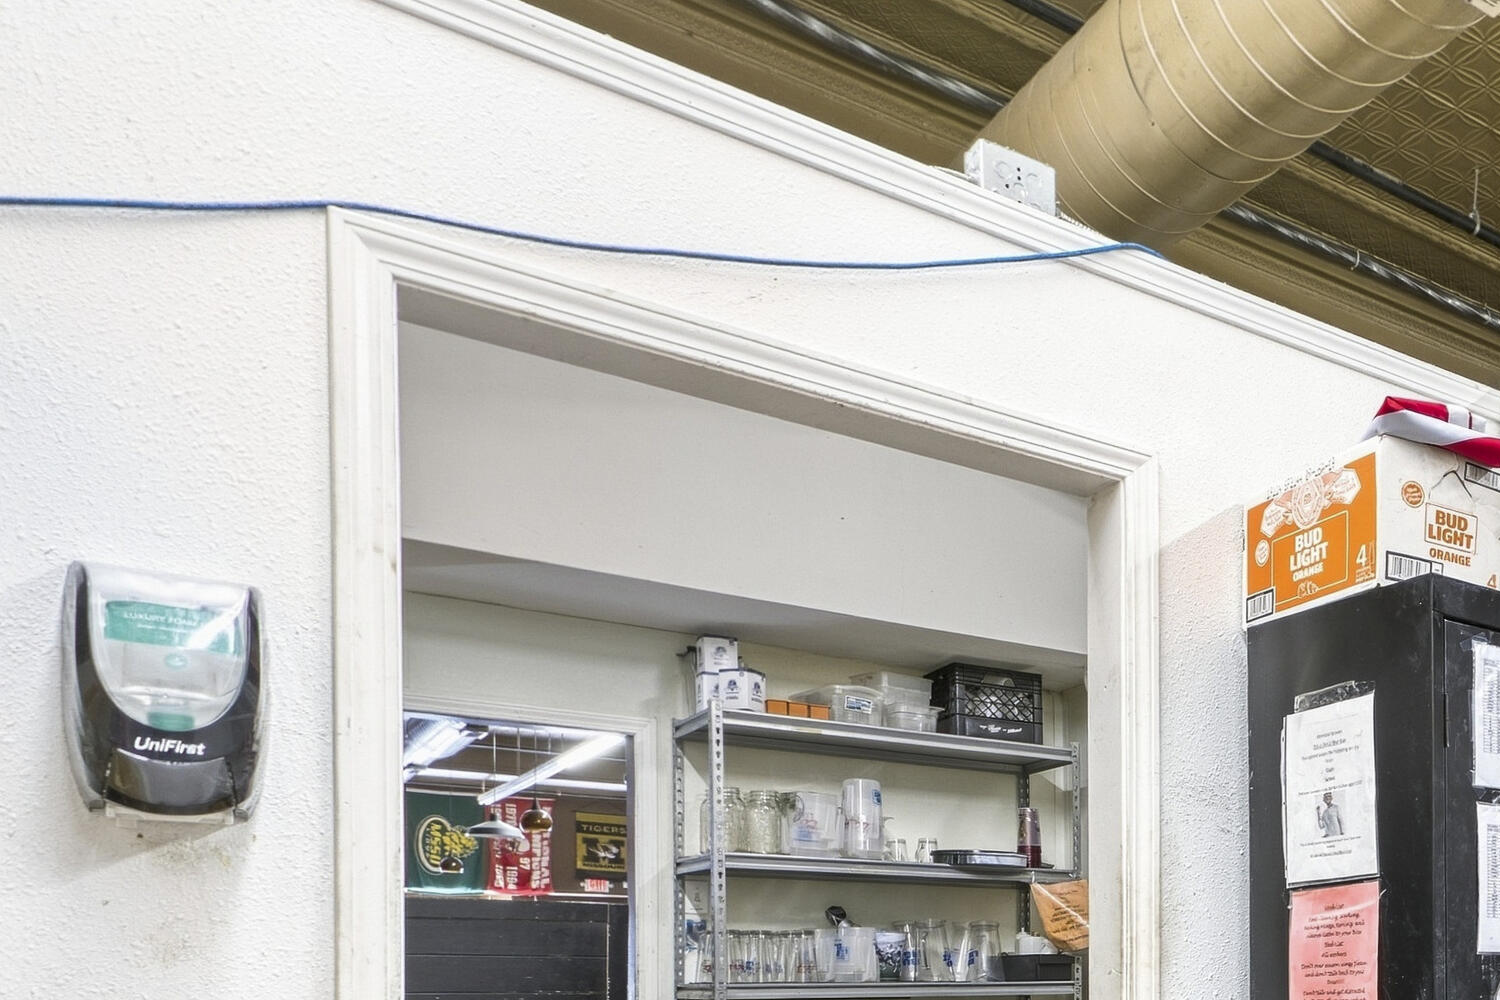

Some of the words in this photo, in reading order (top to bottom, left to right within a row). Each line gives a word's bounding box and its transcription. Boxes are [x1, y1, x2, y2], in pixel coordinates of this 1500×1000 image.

[1435, 509, 1468, 531] BUD
[1294, 527, 1323, 552] BUD
[1428, 523, 1473, 549] LIGHT
[1289, 542, 1328, 572] LIGHT
[1356, 544, 1368, 566] 4
[1429, 547, 1471, 567] ORANGE
[1293, 562, 1324, 583] ORANGE
[123, 611, 167, 624] LUXURY
[133, 736, 206, 756] UniFirst
[581, 824, 627, 834] TIGERS
[430, 822, 442, 865] MSSU
